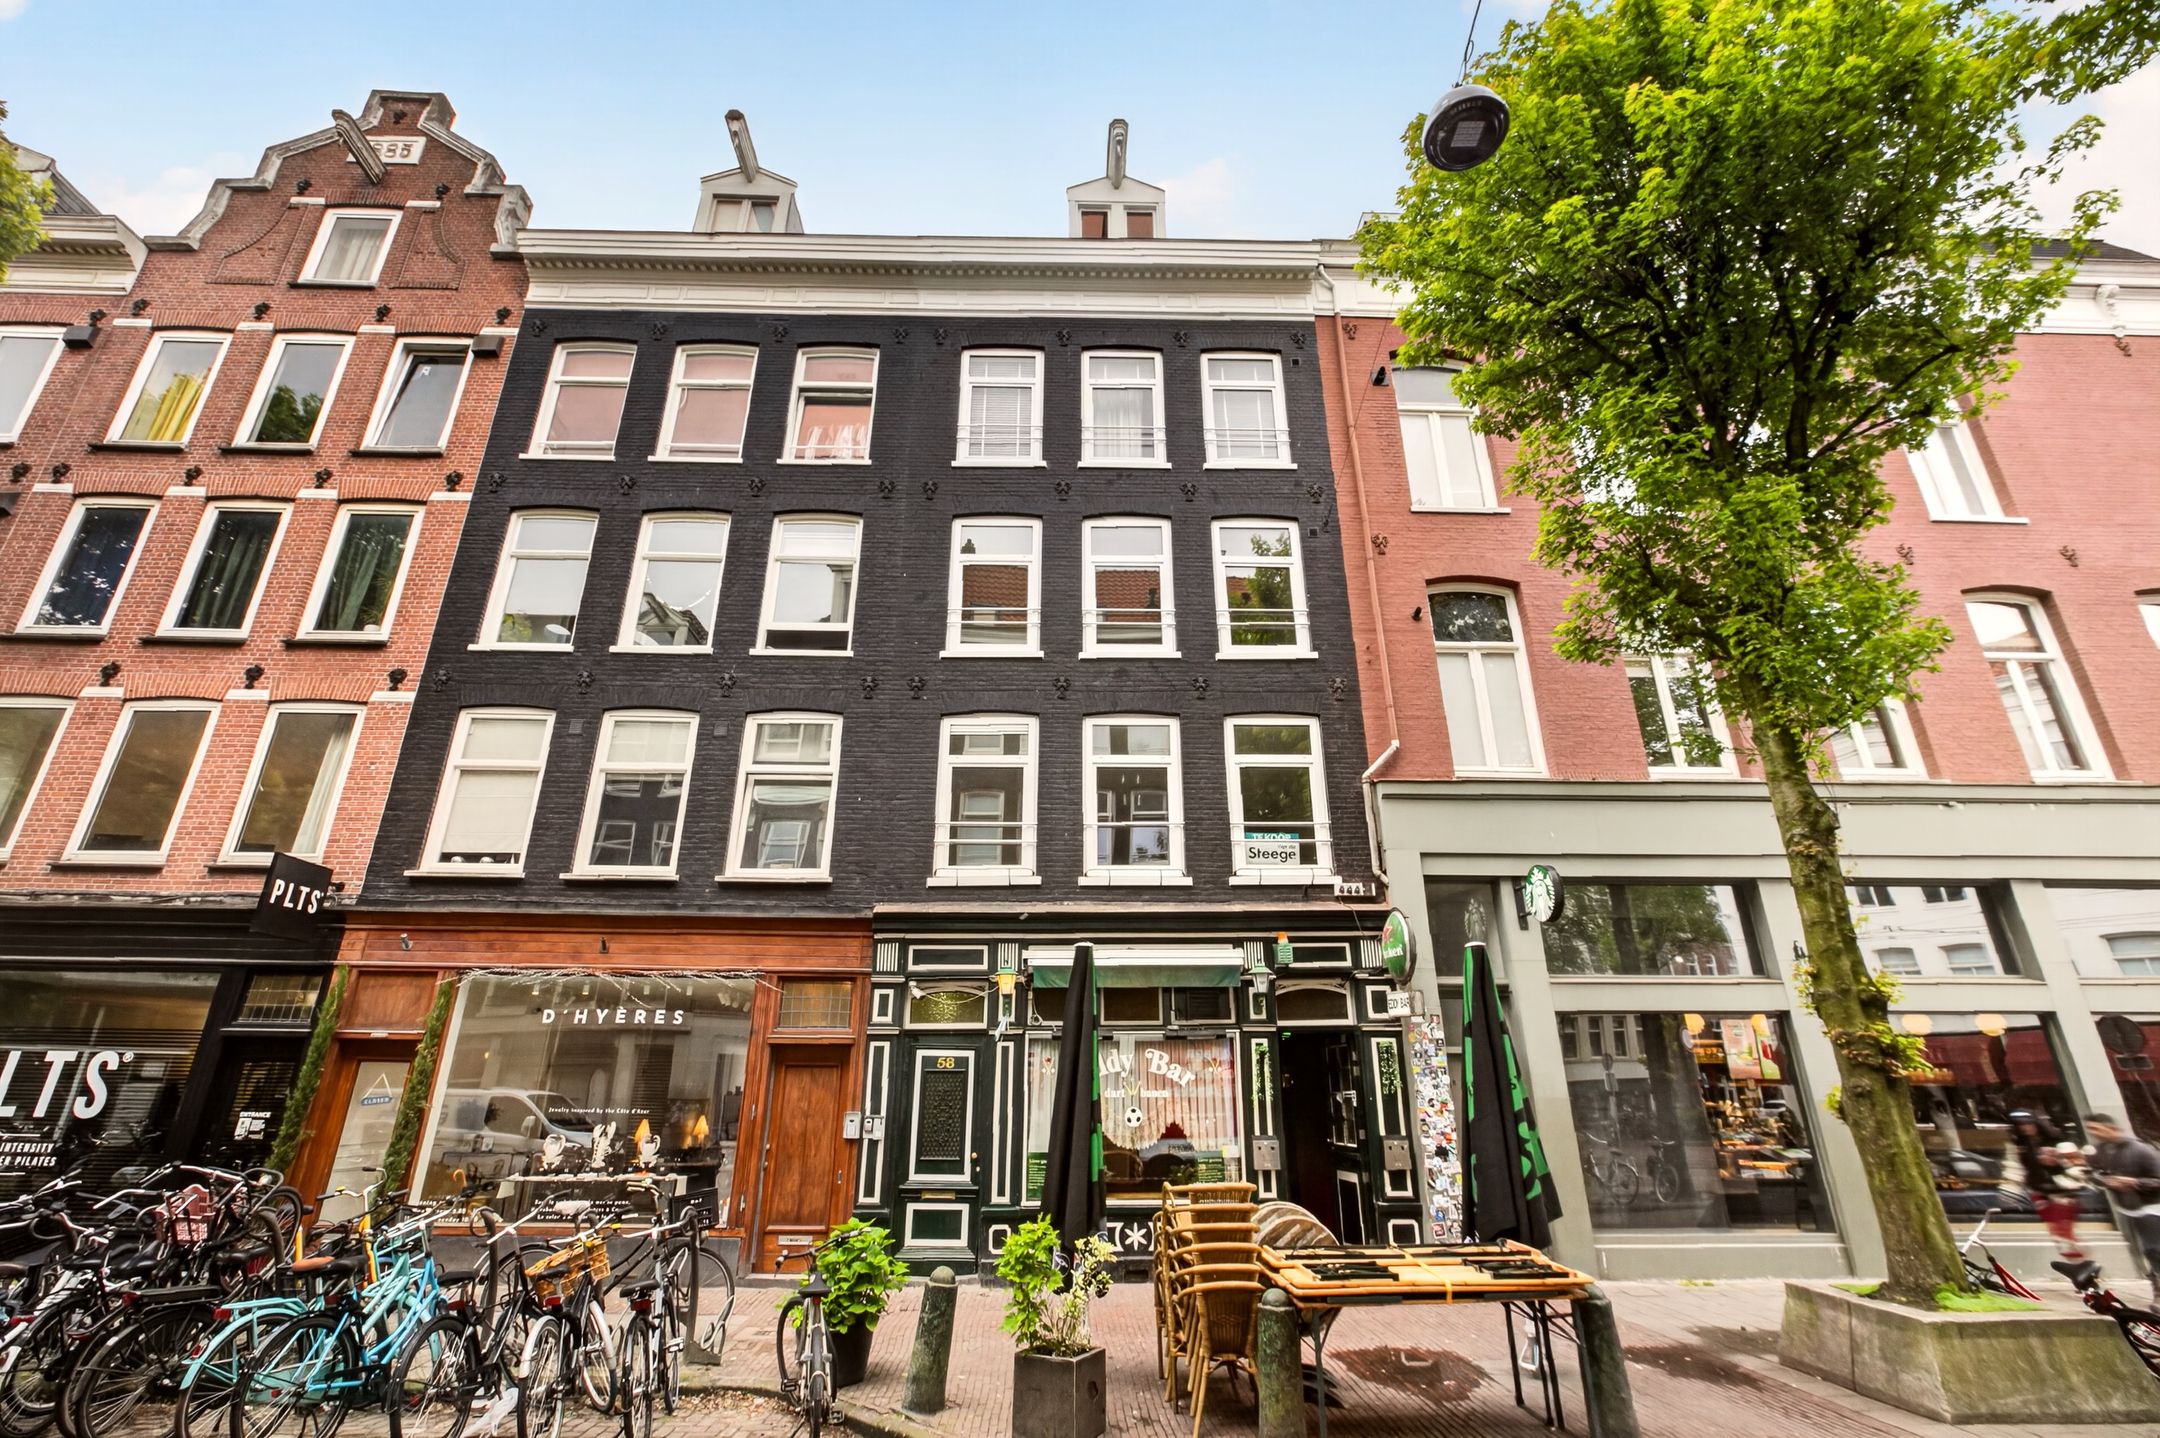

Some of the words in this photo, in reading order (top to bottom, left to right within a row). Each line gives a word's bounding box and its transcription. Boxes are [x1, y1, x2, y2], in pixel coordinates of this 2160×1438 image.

[1248, 846, 1297, 863] Steege
[937, 1057, 955, 1069] 58
[1144, 1048, 1196, 1088] Bar
[1104, 1087, 1125, 1098] dart
[0, 1142, 54, 1153] INTENSITY
[14, 1155, 57, 1167] PILATES
